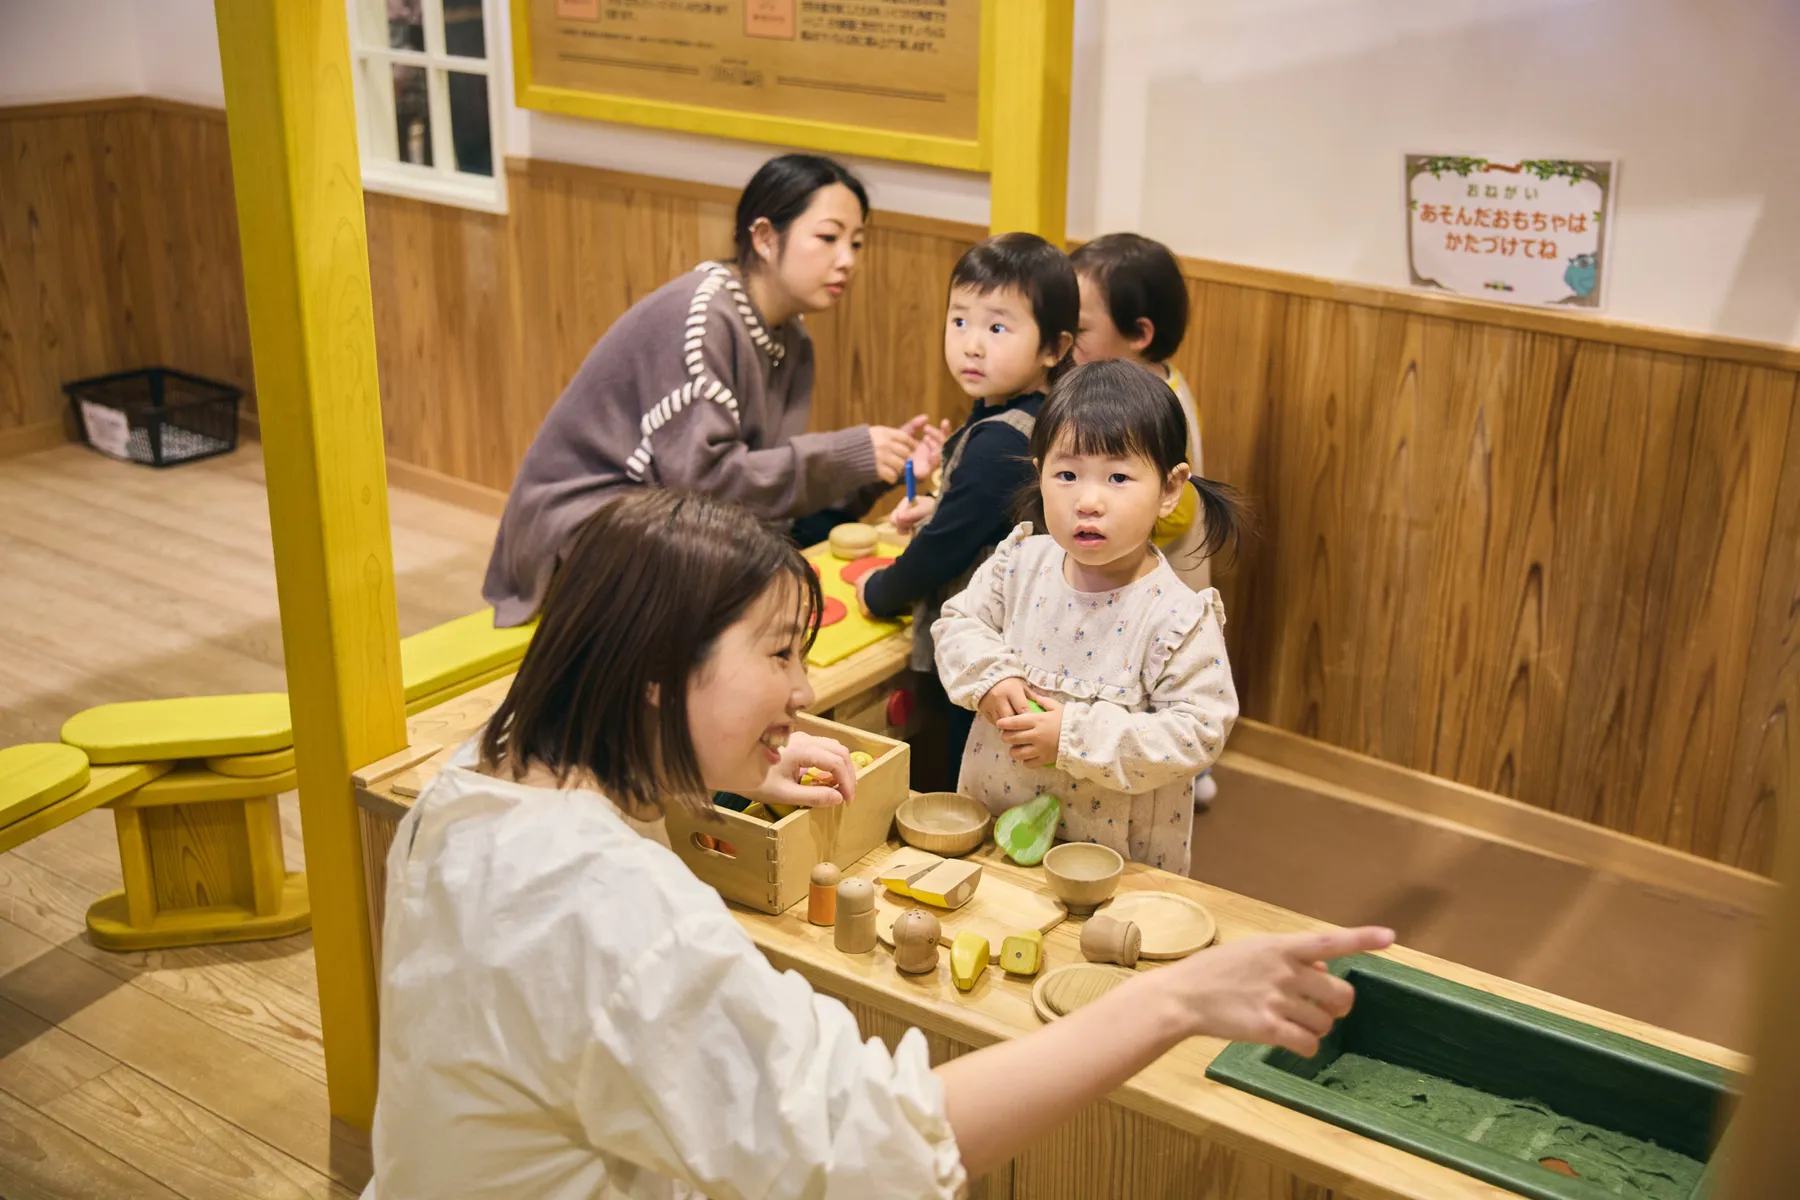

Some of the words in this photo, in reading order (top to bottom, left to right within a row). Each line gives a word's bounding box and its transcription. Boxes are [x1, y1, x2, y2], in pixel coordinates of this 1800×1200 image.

[1467, 184, 1538, 199] おねがい
[1420, 204, 1587, 233] あそんだおもちゃは
[1445, 231, 1557, 259] かたづけてね
